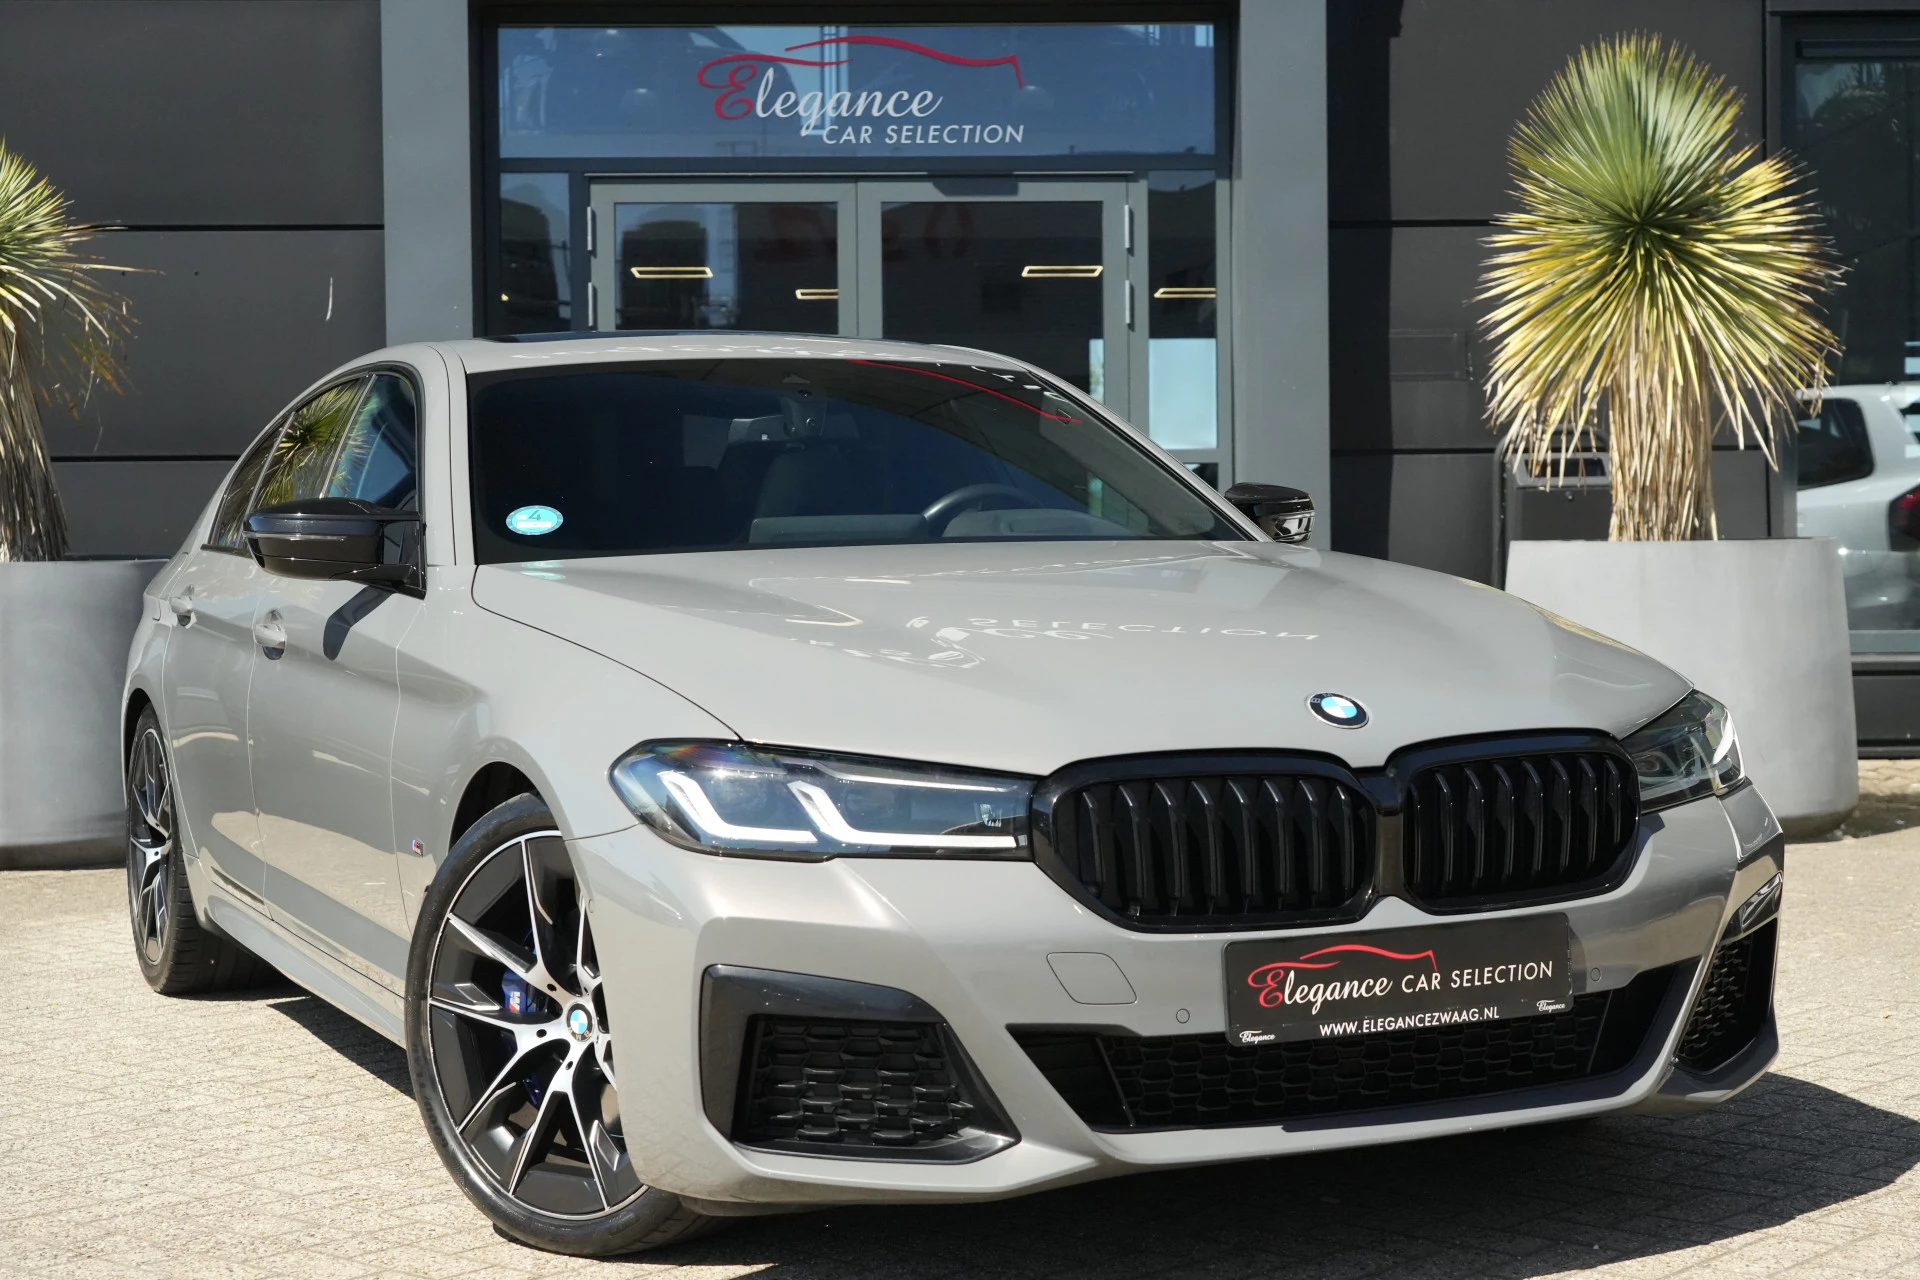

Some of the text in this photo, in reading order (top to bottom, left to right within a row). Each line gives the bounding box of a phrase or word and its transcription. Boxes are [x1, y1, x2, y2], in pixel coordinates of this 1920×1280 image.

[697, 53, 943, 137] Elegance
[822, 124, 1024, 144] CAR SELECTION
[528, 509, 542, 521] 4
[1247, 960, 1553, 1016] Elegance CAR SELECTION
[1536, 999, 1566, 1013] Elegance
[1319, 1006, 1500, 1037] WWW.ELEGANCEZWAAG.NL
[1239, 1029, 1276, 1045] Elegance
